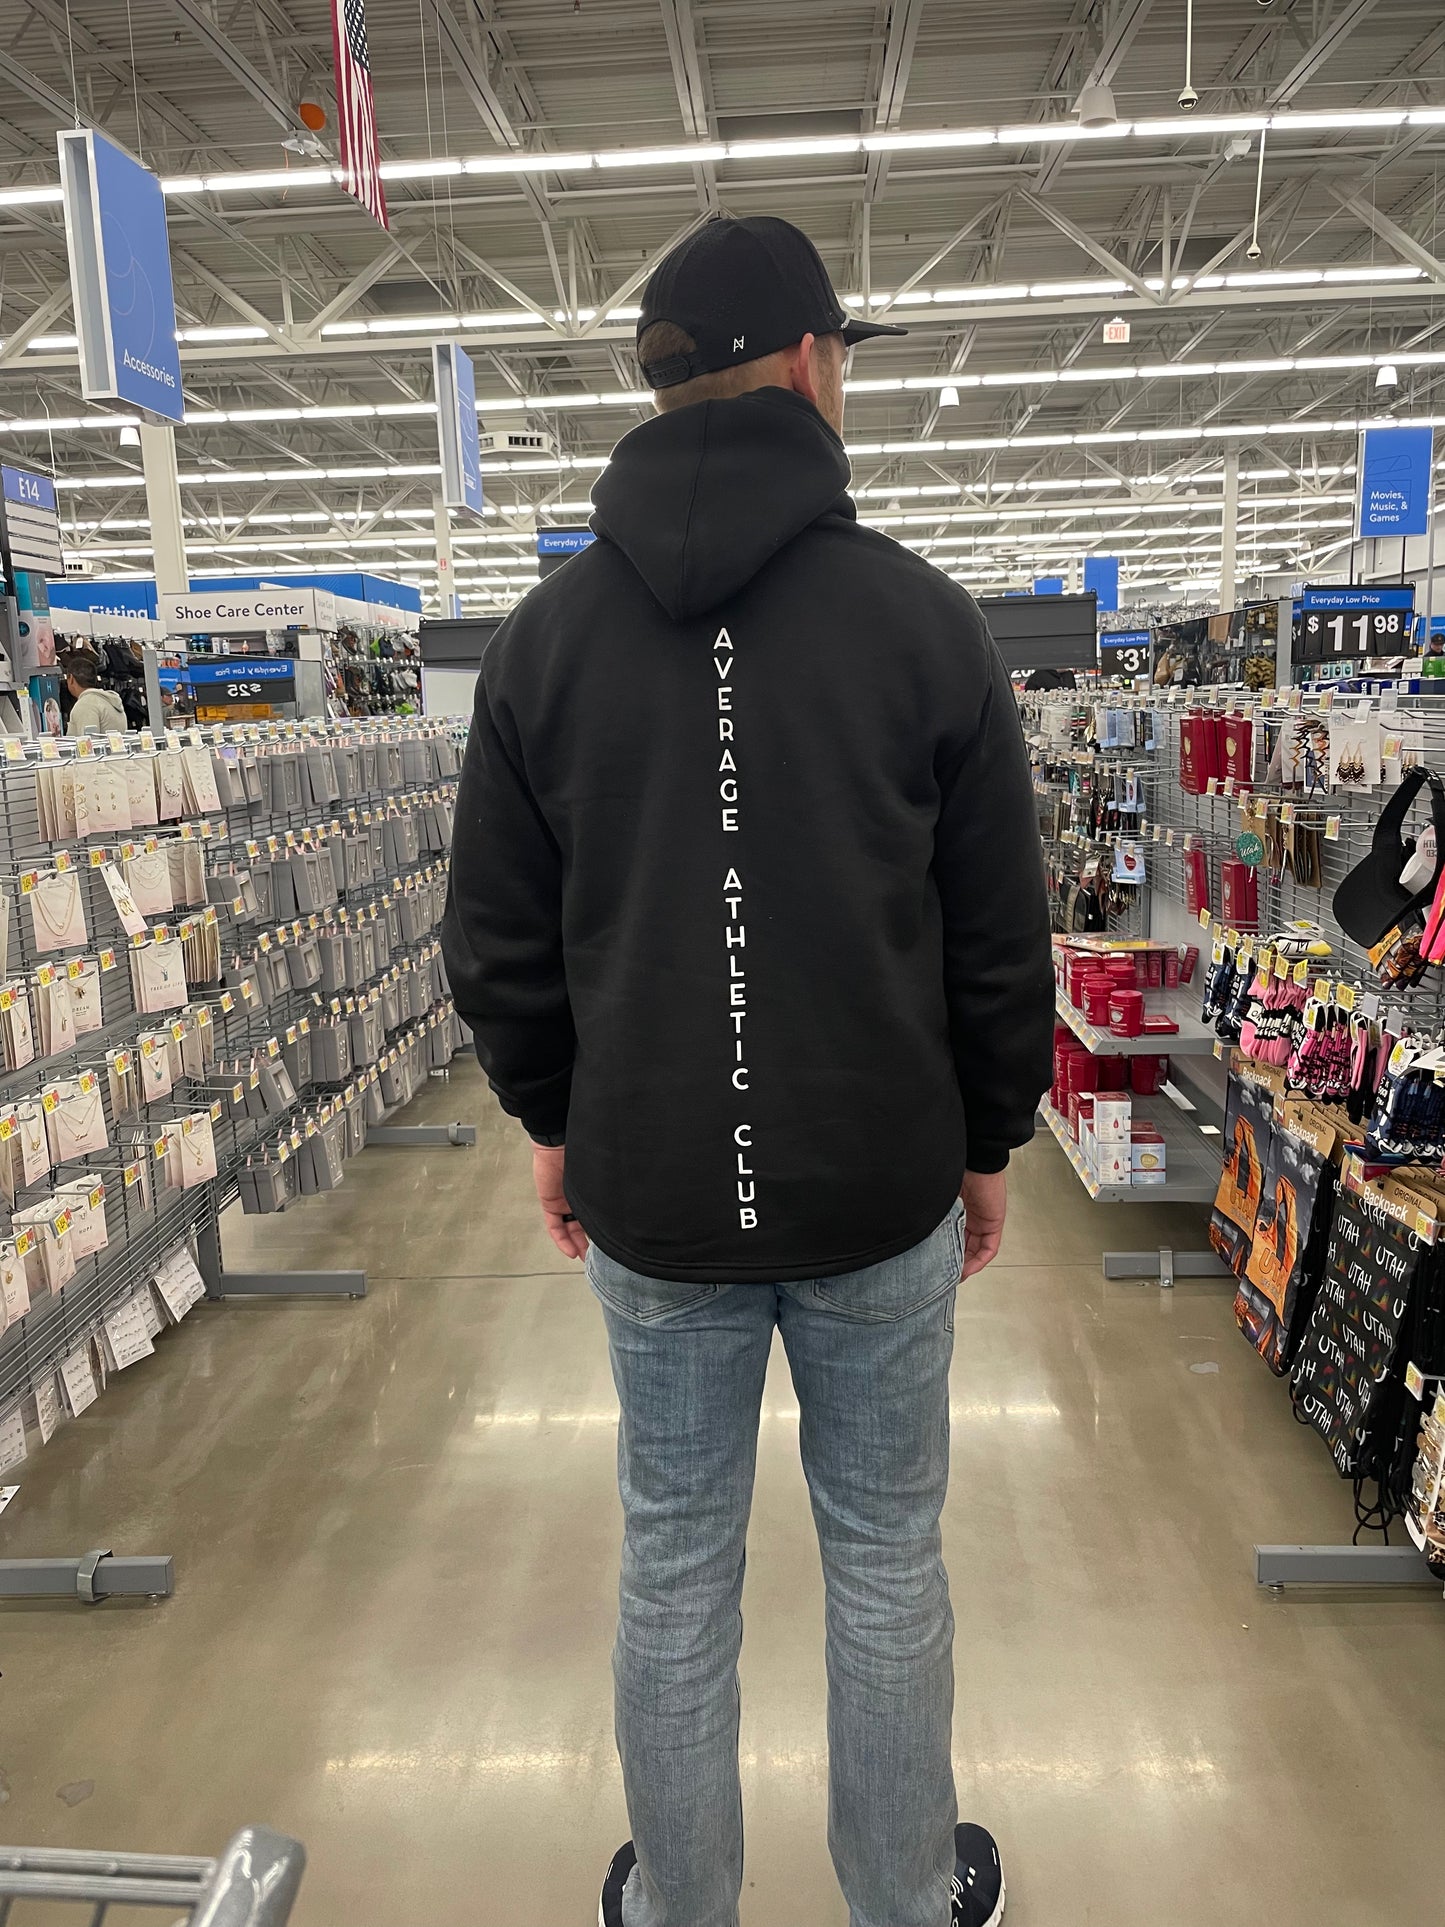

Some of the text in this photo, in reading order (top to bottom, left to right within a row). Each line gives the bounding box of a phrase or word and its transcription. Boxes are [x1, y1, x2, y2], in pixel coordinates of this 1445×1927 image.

[1108, 326, 1126, 340] EXIT
[123, 348, 176, 388] Accessories
[18, 477, 40, 501] E14
[1370, 490, 1405, 500] Movies,
[1369, 513, 1400, 523] Games
[1370, 501, 1408, 512] Music, &
[544, 538, 579, 548] Everyday
[175, 606, 212, 620] Shoe
[215, 604, 250, 618] Care
[254, 602, 305, 617] Center
[1310, 595, 1381, 606] Everyday Low Price
[713, 627, 758, 1230] AVERAGE ATHLETIC CLUB
[1242, 1066, 1272, 1088] Backpack
[1288, 1118, 1319, 1147] Backpack
[1359, 1197, 1387, 1231] UTAH
[1363, 1185, 1409, 1222] Backpack
[1394, 1187, 1422, 1210] ORIGINAL
[1337, 1214, 1360, 1247] UTAH
[1348, 1261, 1373, 1296] UTAH
[1375, 1245, 1407, 1283] UTAH
[1325, 1275, 1346, 1310] UTAH
[1342, 1323, 1366, 1362] UTAH
[1363, 1310, 1393, 1349] UTAH
[1318, 1334, 1346, 1372] UTAH
[1303, 1394, 1334, 1434] UTAH
[1336, 1387, 1355, 1425] UTAH
